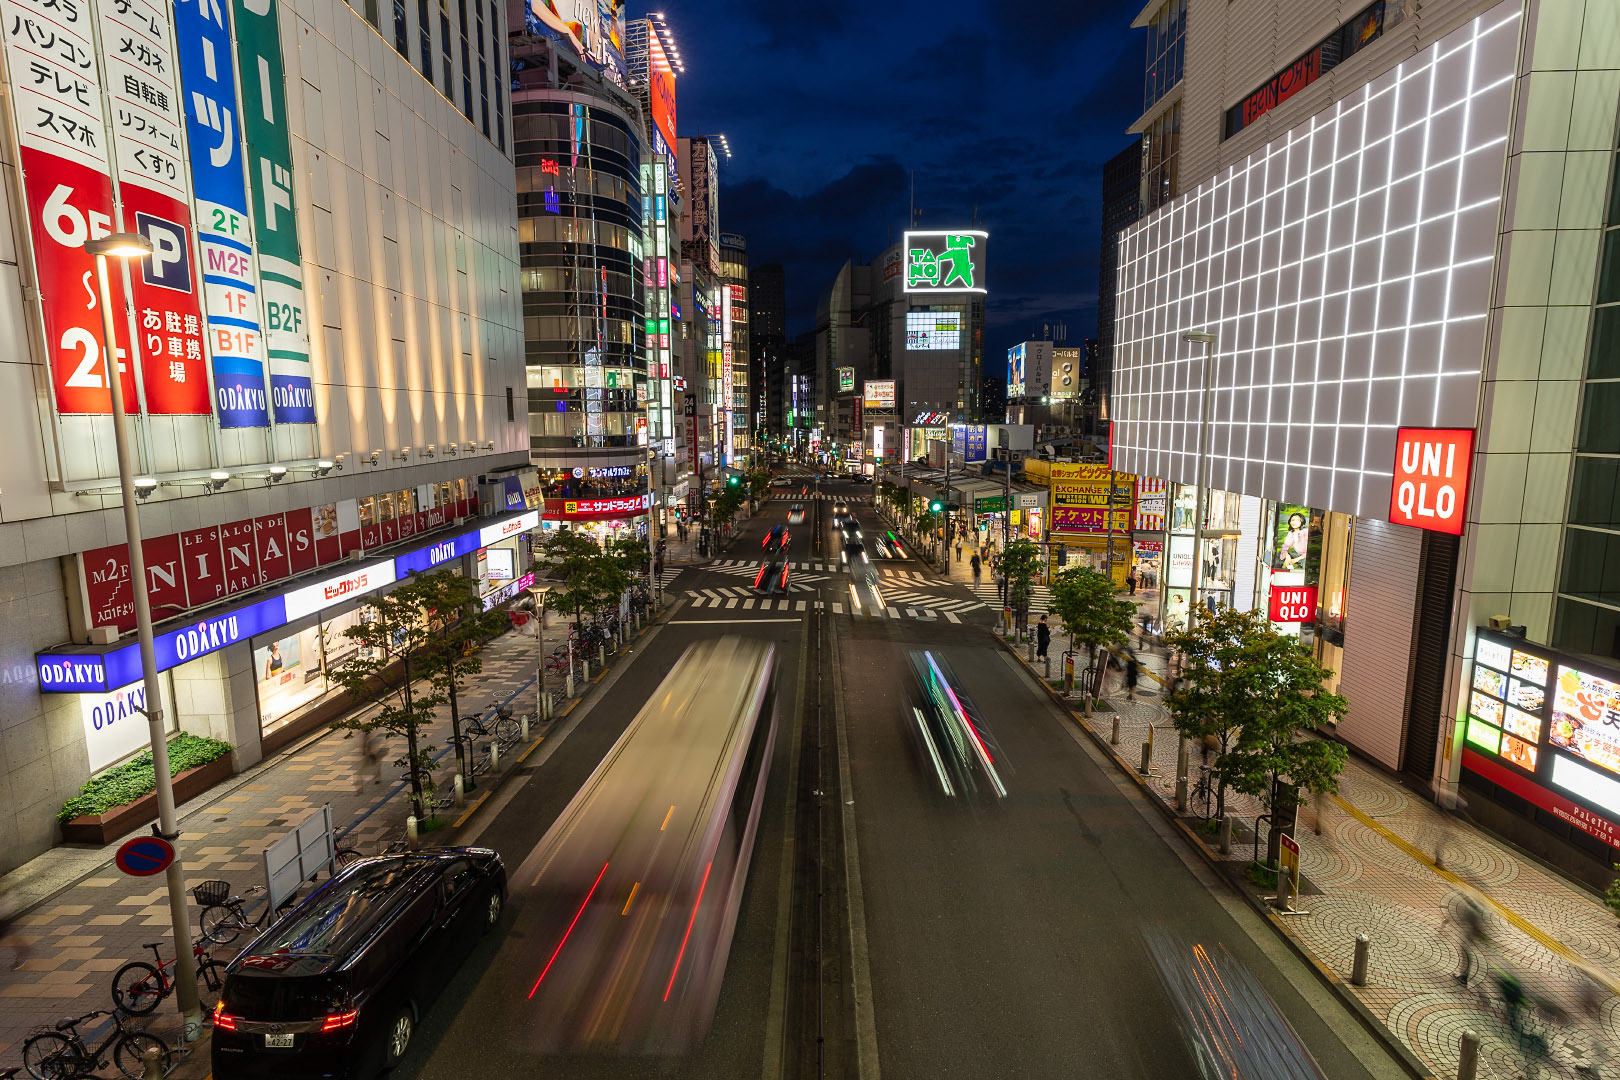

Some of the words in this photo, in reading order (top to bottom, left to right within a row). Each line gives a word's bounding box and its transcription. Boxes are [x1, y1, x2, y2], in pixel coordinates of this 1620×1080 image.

[11, 15, 92, 69] パソコン
[119, 37, 165, 74] メガネ
[30, 61, 90, 107] テレビ
[123, 75, 170, 112] 自転車
[37, 107, 97, 148] スマホ
[119, 109, 179, 150] リフォーム
[133, 149, 176, 180] くすり
[691, 141, 708, 241] カラオケの鉄人
[42, 183, 112, 248] 6F
[212, 208, 240, 235] 2F
[147, 223, 181, 279] P
[207, 248, 249, 277] M2F
[910, 263, 937, 278] NO
[224, 291, 247, 315] 1F
[267, 301, 302, 334] B2F
[142, 307, 163, 357] あり
[165, 311, 186, 383] 駐車場
[184, 312, 201, 361] 提携
[217, 329, 255, 354] B1F
[60, 327, 127, 389] 2F
[218, 384, 266, 411] ODAKYU
[274, 384, 313, 409] ODAKYU
[684, 397, 694, 406] 24
[686, 428, 694, 463] カラオケ
[1402, 441, 1456, 478] UNI
[589, 467, 630, 478] サンマルクカフェ
[593, 499, 635, 511] サンドラッグ
[1055, 486, 1102, 494] EXCHANGE
[1397, 481, 1456, 520] QLO
[1054, 509, 1103, 522] チケット
[184, 534, 203, 547] LE
[210, 521, 264, 541] SALON
[268, 517, 284, 529] DE
[147, 528, 310, 593] NINA'S
[430, 541, 455, 566] ODAKYU
[92, 558, 129, 585] M2F
[215, 570, 268, 597] PARIS
[324, 574, 368, 601] ビックカメラ
[1280, 591, 1307, 604] UNI
[97, 601, 135, 623] 入口1Fより
[1280, 606, 1309, 621] QLO
[176, 616, 239, 661] ODAKYU
[41, 661, 105, 684] ODAKYU
